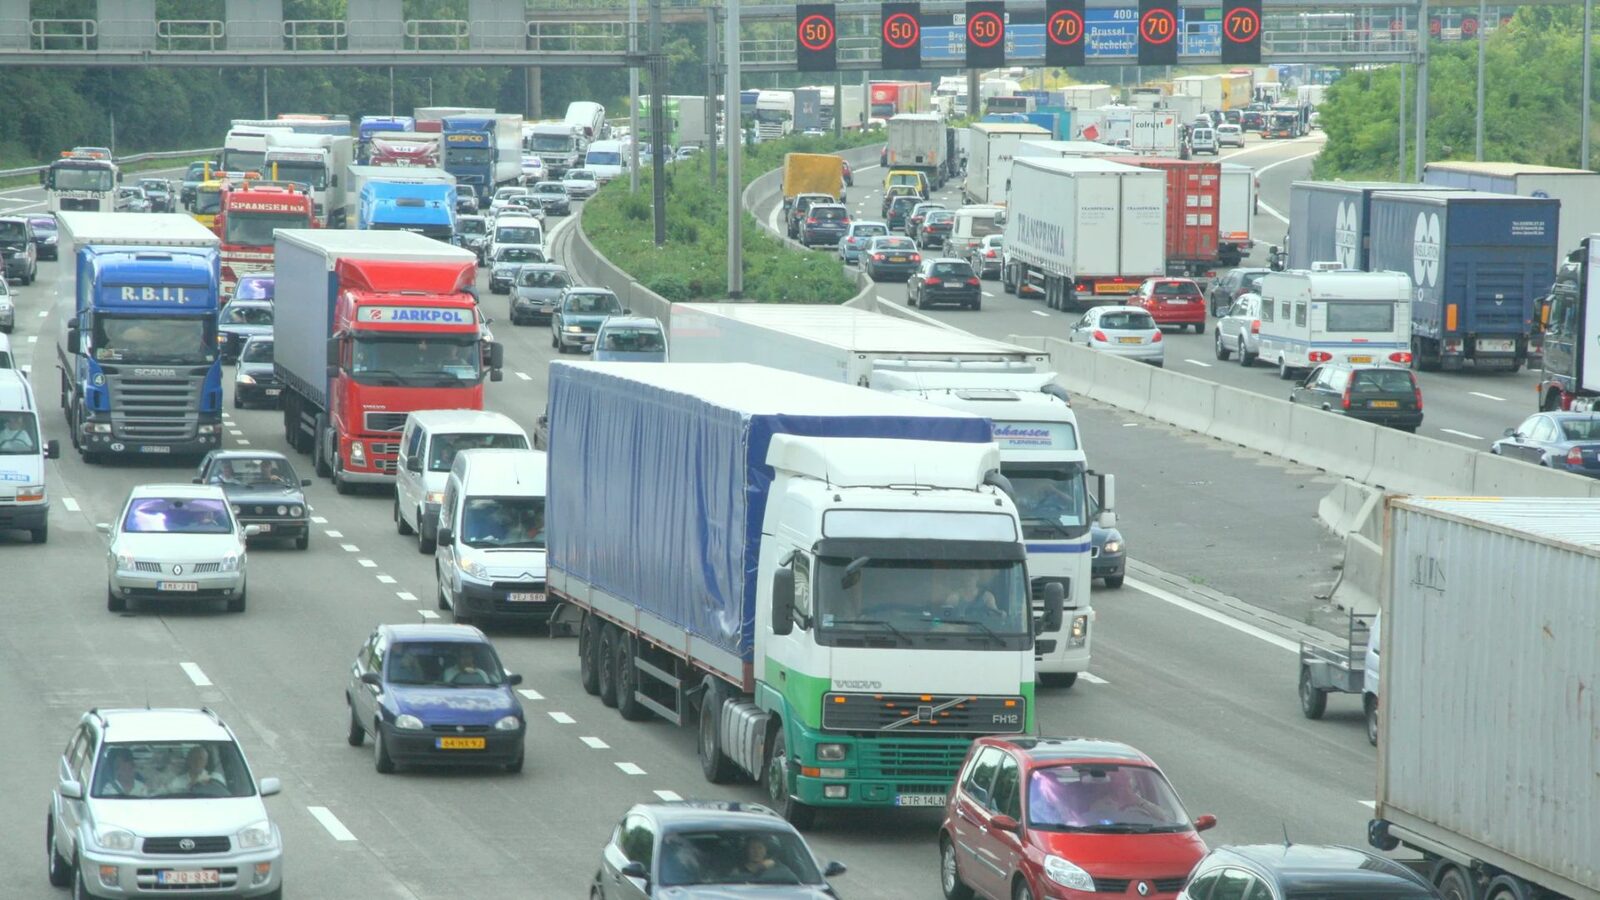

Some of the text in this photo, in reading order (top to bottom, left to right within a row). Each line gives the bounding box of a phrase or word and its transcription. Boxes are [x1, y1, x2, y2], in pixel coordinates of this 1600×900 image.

[1113, 9, 1132, 20] 400
[890, 22, 911, 39] 50
[975, 21, 996, 37] 50
[1055, 19, 1076, 36] 70
[1148, 18, 1168, 35] 70
[1231, 17, 1251, 33] 70
[805, 24, 827, 40] 50
[1091, 26, 1125, 36] Brussel
[1091, 39, 1133, 50] Mechelen
[1136, 121, 1164, 130] colruyt
[447, 134, 483, 142] GEFCO
[230, 201, 288, 211] SPAANSEN
[1017, 212, 1065, 257] TRANSPRISMA
[392, 309, 463, 323] JARKPOL
[134, 368, 176, 376] SCANIA
[832, 679, 883, 690] VOLVO
[991, 714, 1018, 724] FH12
[901, 795, 920, 805] CTR
